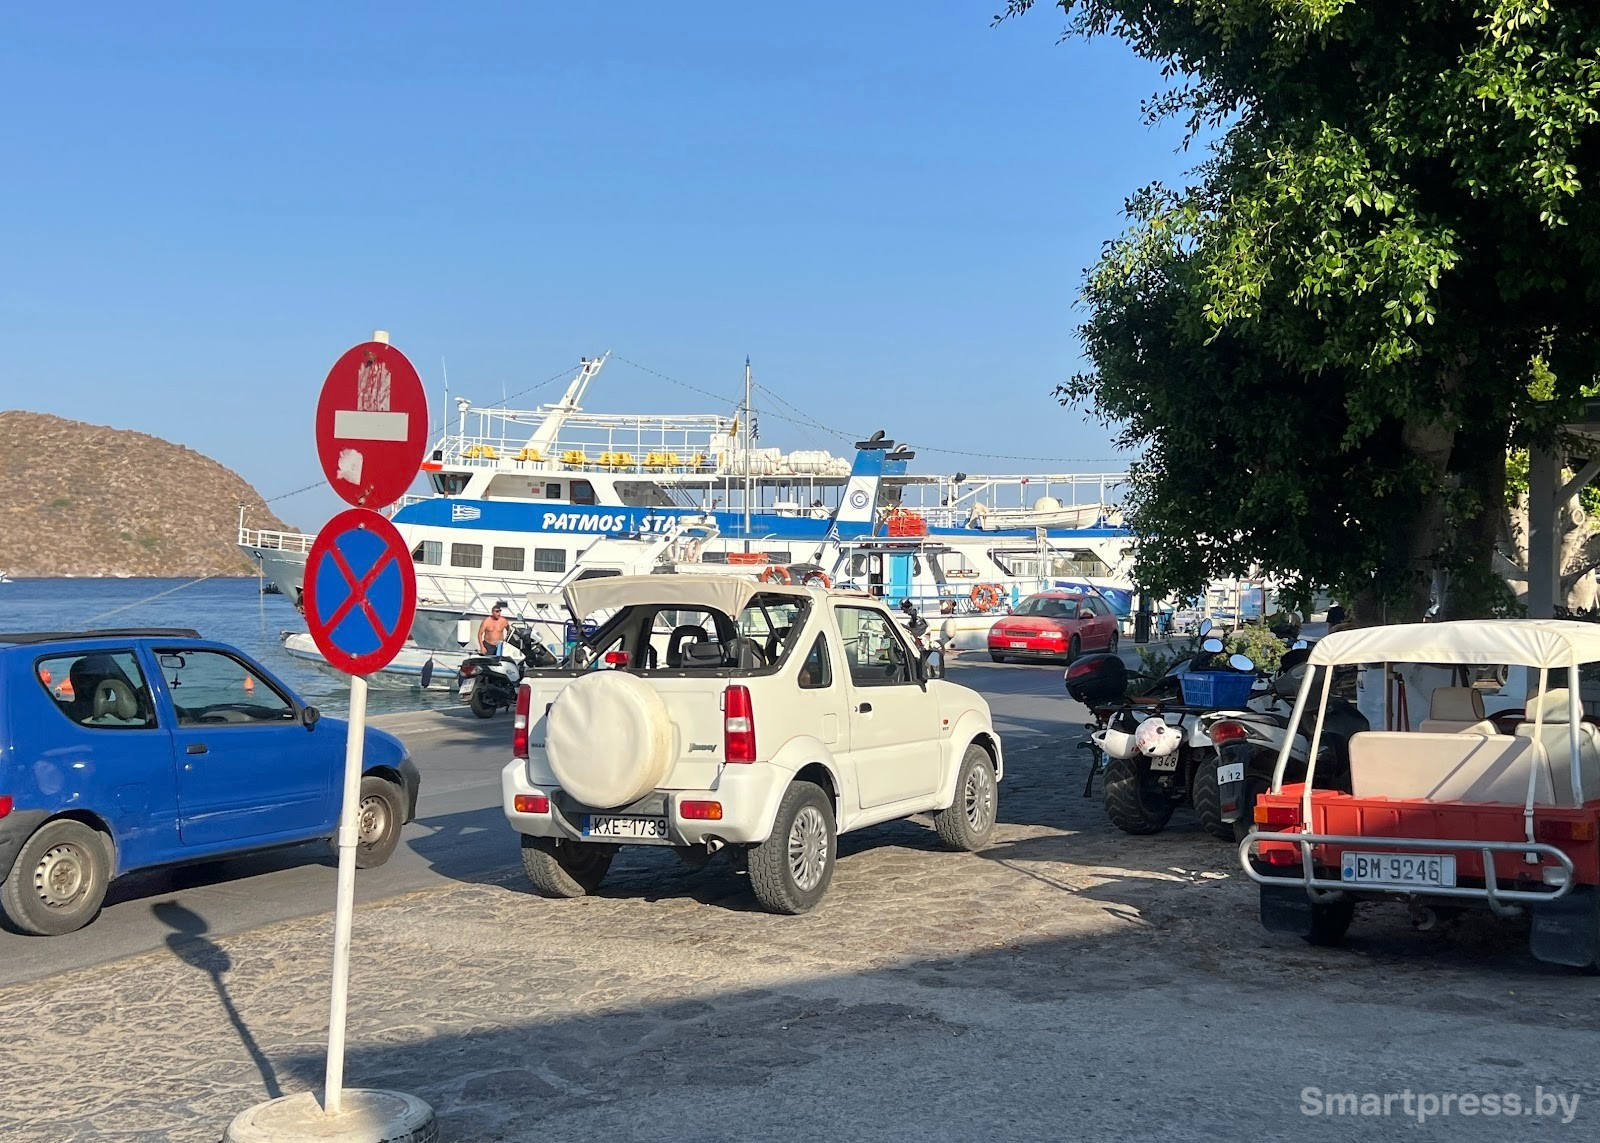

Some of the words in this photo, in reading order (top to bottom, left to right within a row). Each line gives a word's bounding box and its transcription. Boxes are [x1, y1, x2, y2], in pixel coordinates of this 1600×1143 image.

[542, 512, 626, 532] PATMOS
[638, 515, 682, 532] STA
[1157, 756, 1177, 768] 348
[594, 817, 666, 836] KXE-1739
[1357, 857, 1440, 883] BM-9246
